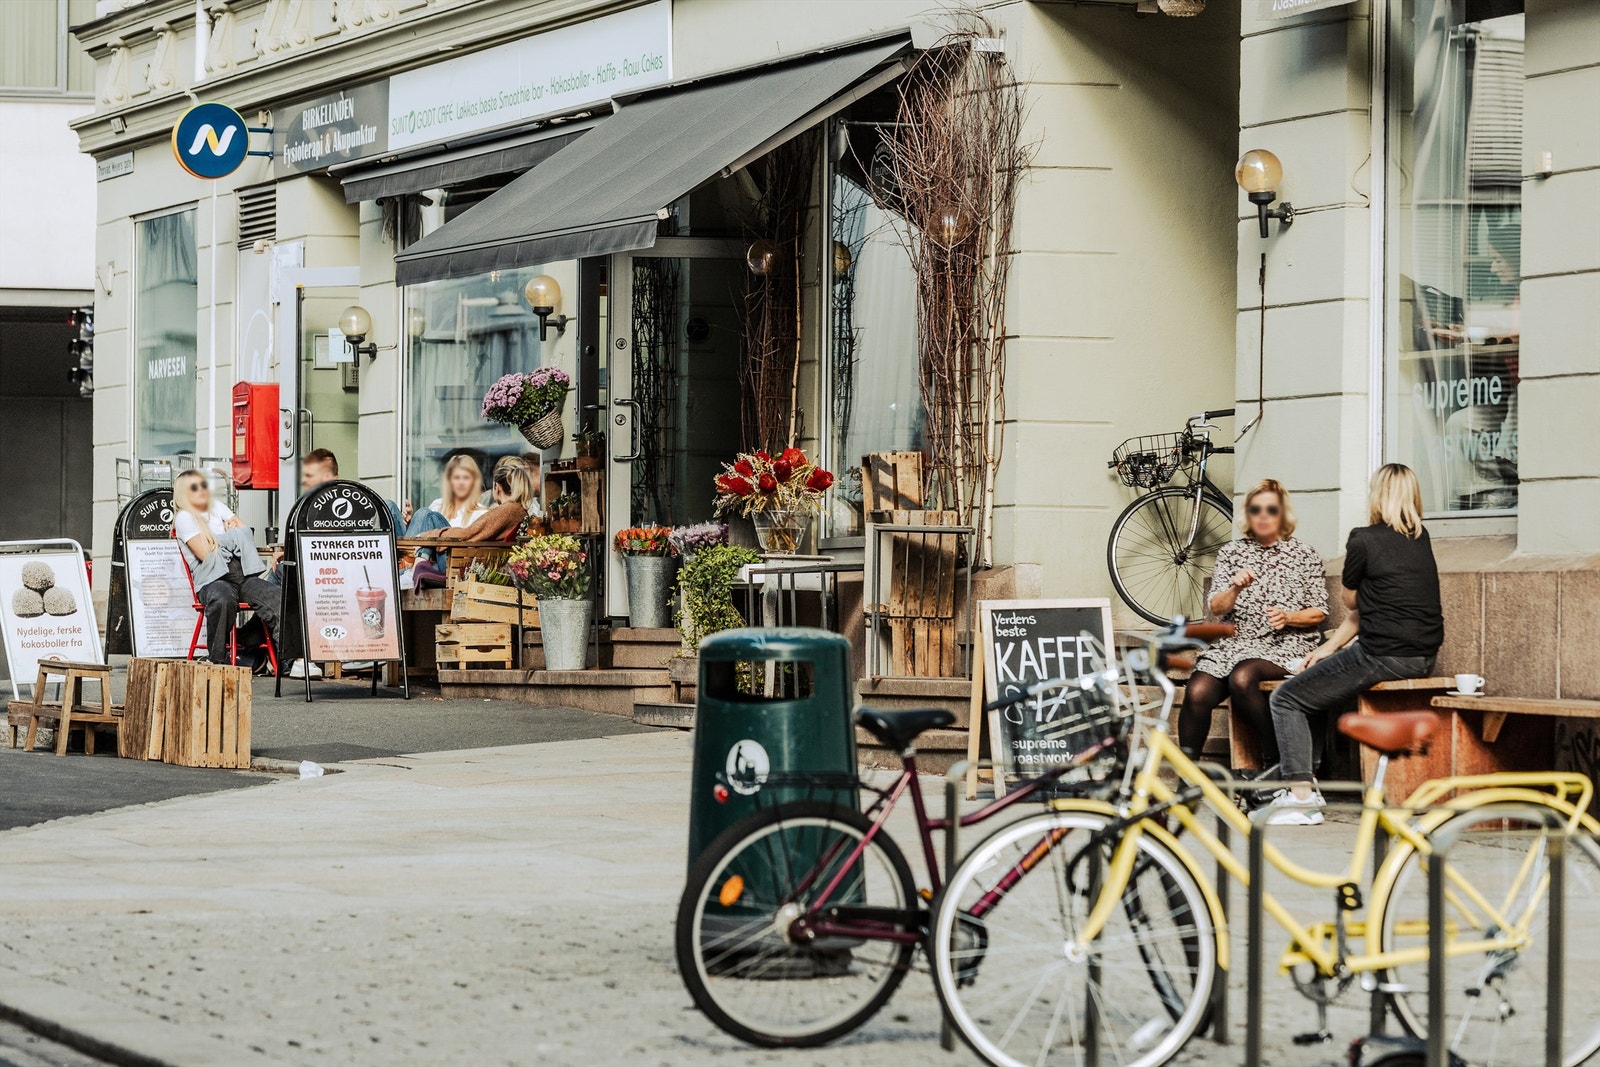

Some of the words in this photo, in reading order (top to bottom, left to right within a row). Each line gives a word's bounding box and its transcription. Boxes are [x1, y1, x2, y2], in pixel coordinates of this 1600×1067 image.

[391, 115, 408, 135] SUNT
[416, 107, 436, 129] GODT
[480, 96, 497, 114] beste
[499, 85, 530, 109] Smoothie
[531, 82, 544, 100] bar
[550, 70, 590, 95] Kokosboller
[596, 62, 617, 85] Kaffe
[623, 59, 639, 78] Raw
[641, 52, 663, 72] Cakes
[302, 97, 354, 130] BIRKELUNDEN
[283, 135, 324, 168] Fysioterapi
[325, 133, 331, 154] &
[332, 124, 377, 153] Akupunktur
[149, 356, 186, 380] NARVESEN
[1413, 376, 1502, 417] supreme
[313, 489, 338, 511] SUNT
[342, 488, 373, 510] GODT
[140, 500, 158, 518] SUNT
[160, 499, 167, 508] &
[139, 524, 171, 532] ØKOLOG
[313, 519, 357, 528] ØKOLOGISK
[311, 540, 354, 549] STYRKER
[357, 540, 380, 548] DITT
[310, 551, 383, 561] IMUNFORSVAR
[318, 567, 339, 575] RØD
[315, 577, 345, 585] DETOX
[16, 627, 55, 638] Nydelige,
[57, 625, 82, 634] ferske
[995, 626, 1027, 637] beste
[21, 639, 69, 649] kokosboller
[70, 638, 83, 647] fra
[995, 636, 1093, 683] KAFFE
[1012, 739, 1067, 751] supreme
[1013, 751, 1075, 765] roastwork
